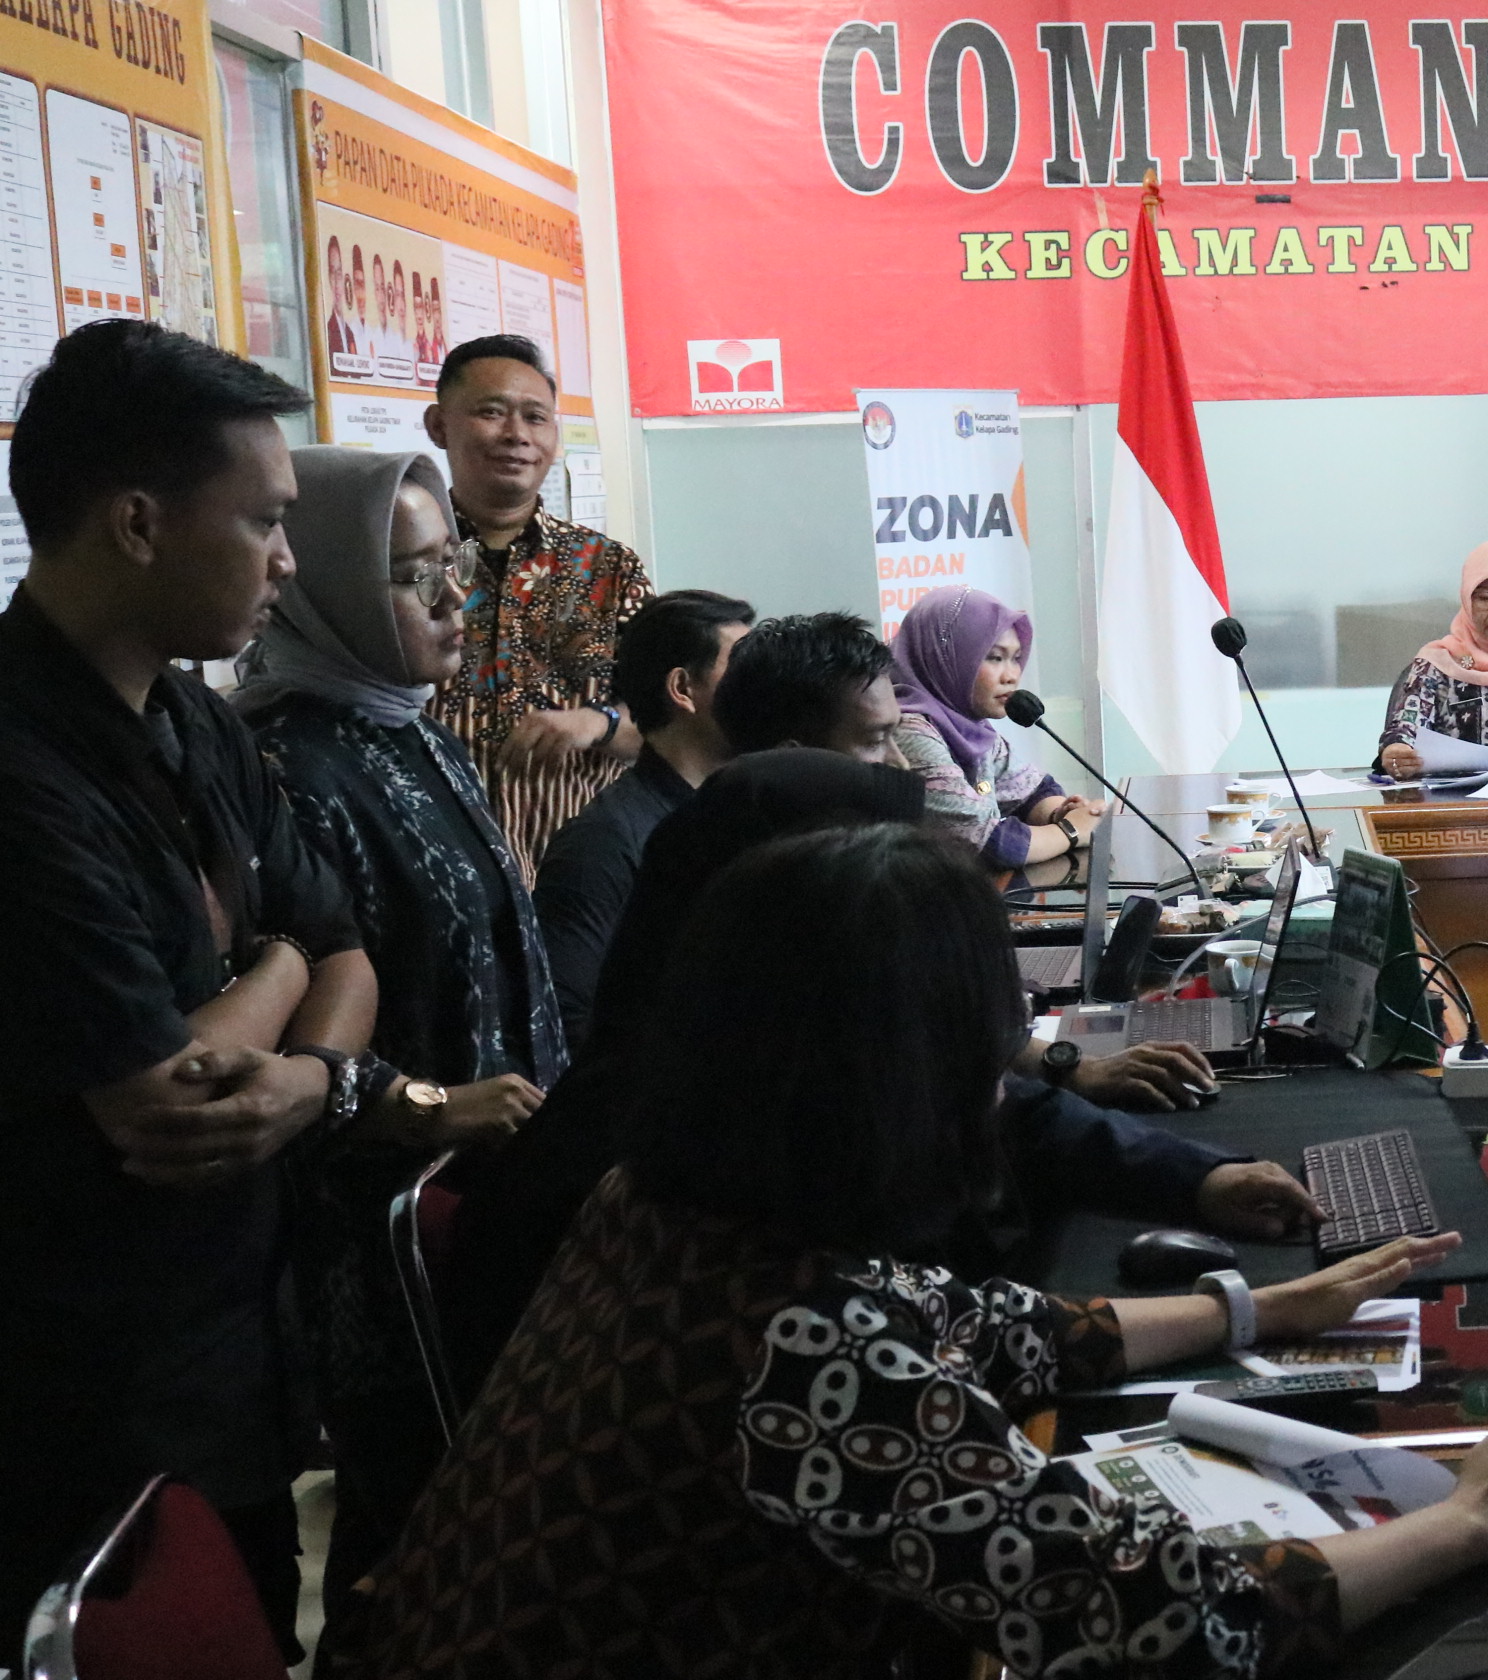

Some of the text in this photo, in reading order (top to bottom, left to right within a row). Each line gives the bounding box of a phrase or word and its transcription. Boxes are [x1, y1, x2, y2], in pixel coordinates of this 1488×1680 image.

[108, 0, 186, 86] GADING
[335, 129, 377, 190] PAPAN
[379, 147, 409, 202] DATA
[411, 161, 454, 219] PILKADA
[960, 223, 1474, 282] KECAMATAN
[693, 397, 782, 411] MAYORA
[974, 412, 1011, 421] Kecamatan
[976, 426, 1020, 436] Kelapa Gading
[875, 493, 1013, 544] ZONA
[877, 553, 965, 580] BADAN
